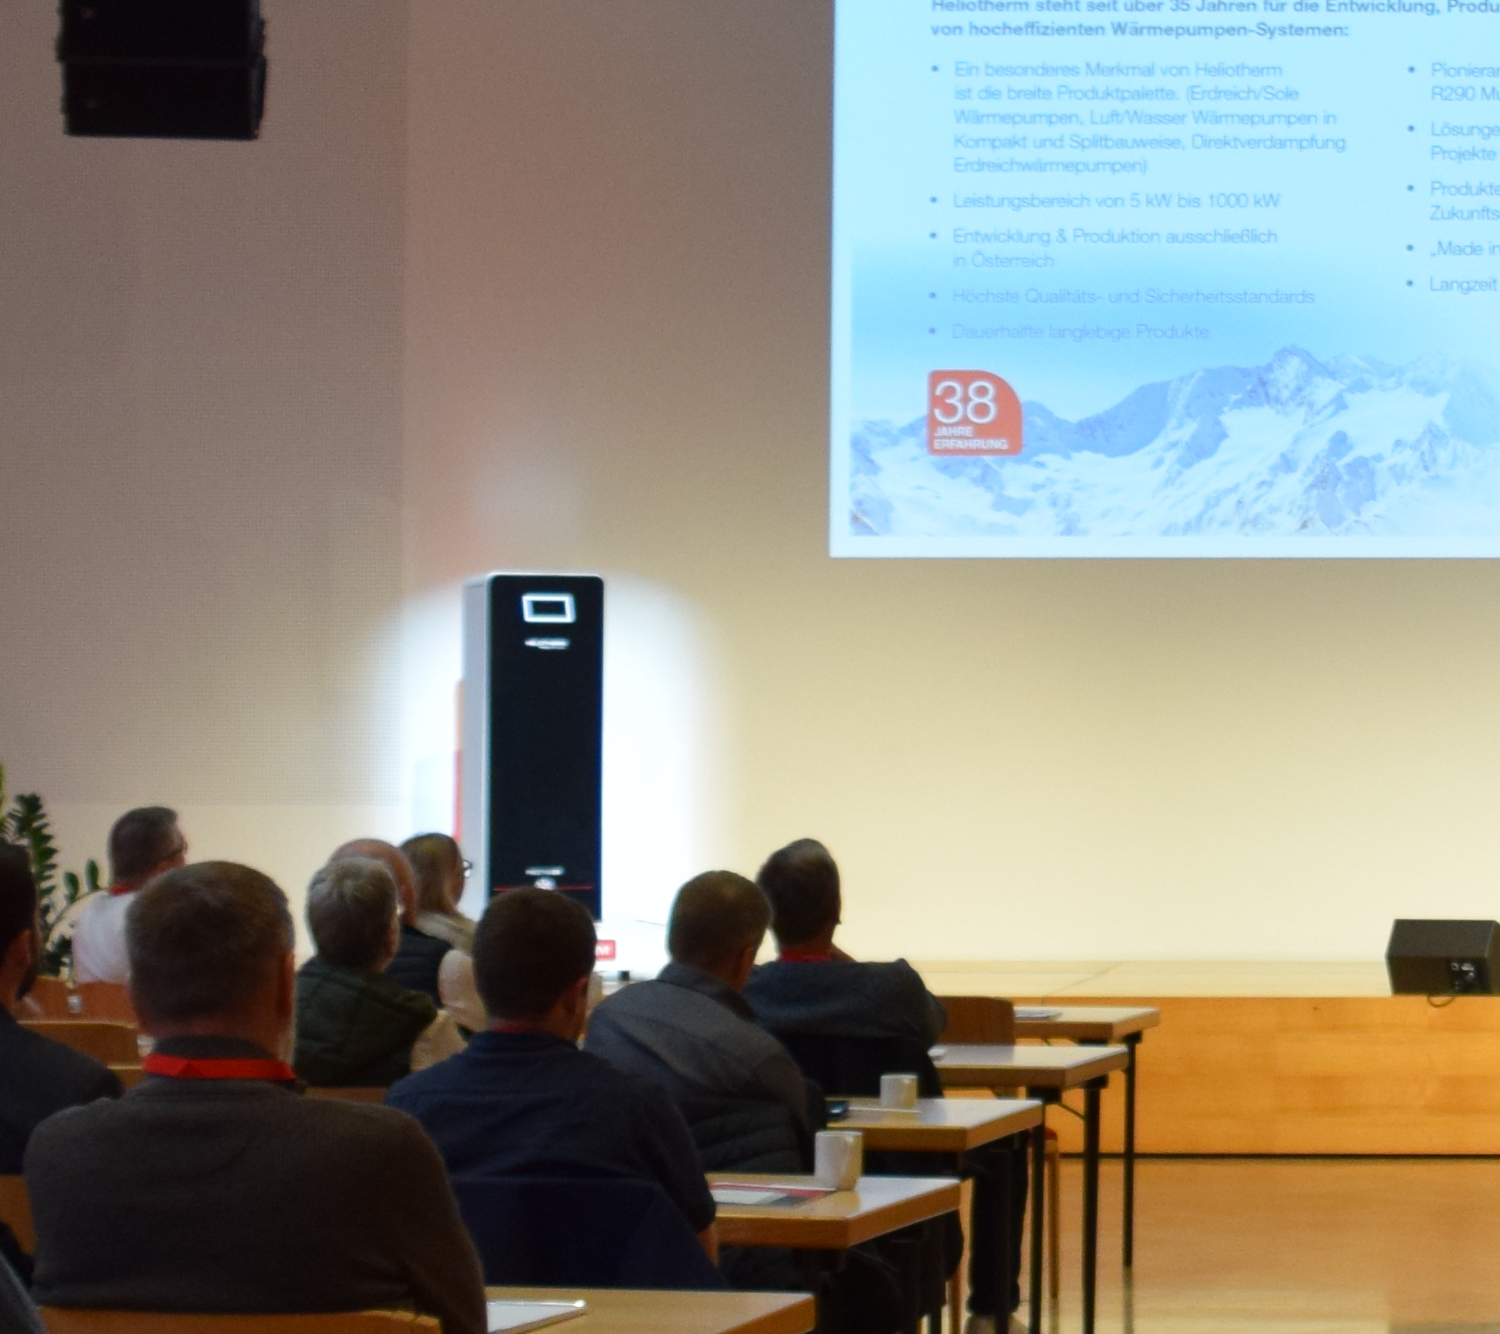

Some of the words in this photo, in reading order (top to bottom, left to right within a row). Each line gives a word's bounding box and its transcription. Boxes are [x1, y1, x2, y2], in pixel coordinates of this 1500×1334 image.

[930, 24, 964, 37] von
[968, 20, 1107, 37] hocheffizienten
[954, 60, 980, 78] Ein
[984, 61, 1081, 78] besonderes
[1084, 61, 1156, 78] Merkmal
[1159, 65, 1190, 78] von
[1194, 61, 1284, 78] Heliotherm
[954, 86, 974, 101] ist
[977, 84, 1003, 101] die
[1006, 85, 1053, 101] breite
[1430, 84, 1477, 102] R290
[953, 108, 1085, 128] Wärmepumpen,
[1089, 108, 1189, 126] Luft/Wasser
[1191, 109, 1319, 128] Wärmepumpen
[1322, 110, 1338, 125] in
[953, 133, 1028, 152] Kompakt
[1032, 134, 1065, 150] und
[1191, 132, 1347, 154] Direktverdampfung
[1430, 144, 1498, 164] Projekte
[953, 156, 1148, 176] Erdreichwärmepumpen)
[953, 193, 1092, 213] Leistungsbereich
[1095, 196, 1126, 209] von
[1129, 191, 1142, 209] 5
[1145, 192, 1173, 208] kW
[1177, 192, 1202, 209] bis
[1208, 192, 1250, 209] 1000
[1253, 192, 1281, 208] kW
[952, 227, 1052, 248] Entwicklung
[1055, 227, 1068, 244] &
[1072, 227, 1162, 244] Produktion
[1165, 227, 1278, 245] ausschließlich
[952, 252, 967, 268] in
[970, 249, 1055, 269] Österreich
[952, 287, 1020, 304] Höchste
[1024, 287, 1103, 304] Qualitäts-
[1108, 288, 1141, 304] und
[1144, 287, 1316, 305] Sicherheitsstandards
[1429, 276, 1499, 296] Langzeit
[1048, 323, 1132, 344] langlebige
[1135, 322, 1210, 340] Produkte
[933, 380, 997, 424] 38
[933, 426, 974, 437] JAHRE
[933, 438, 1009, 450] ERFAHRUNG
